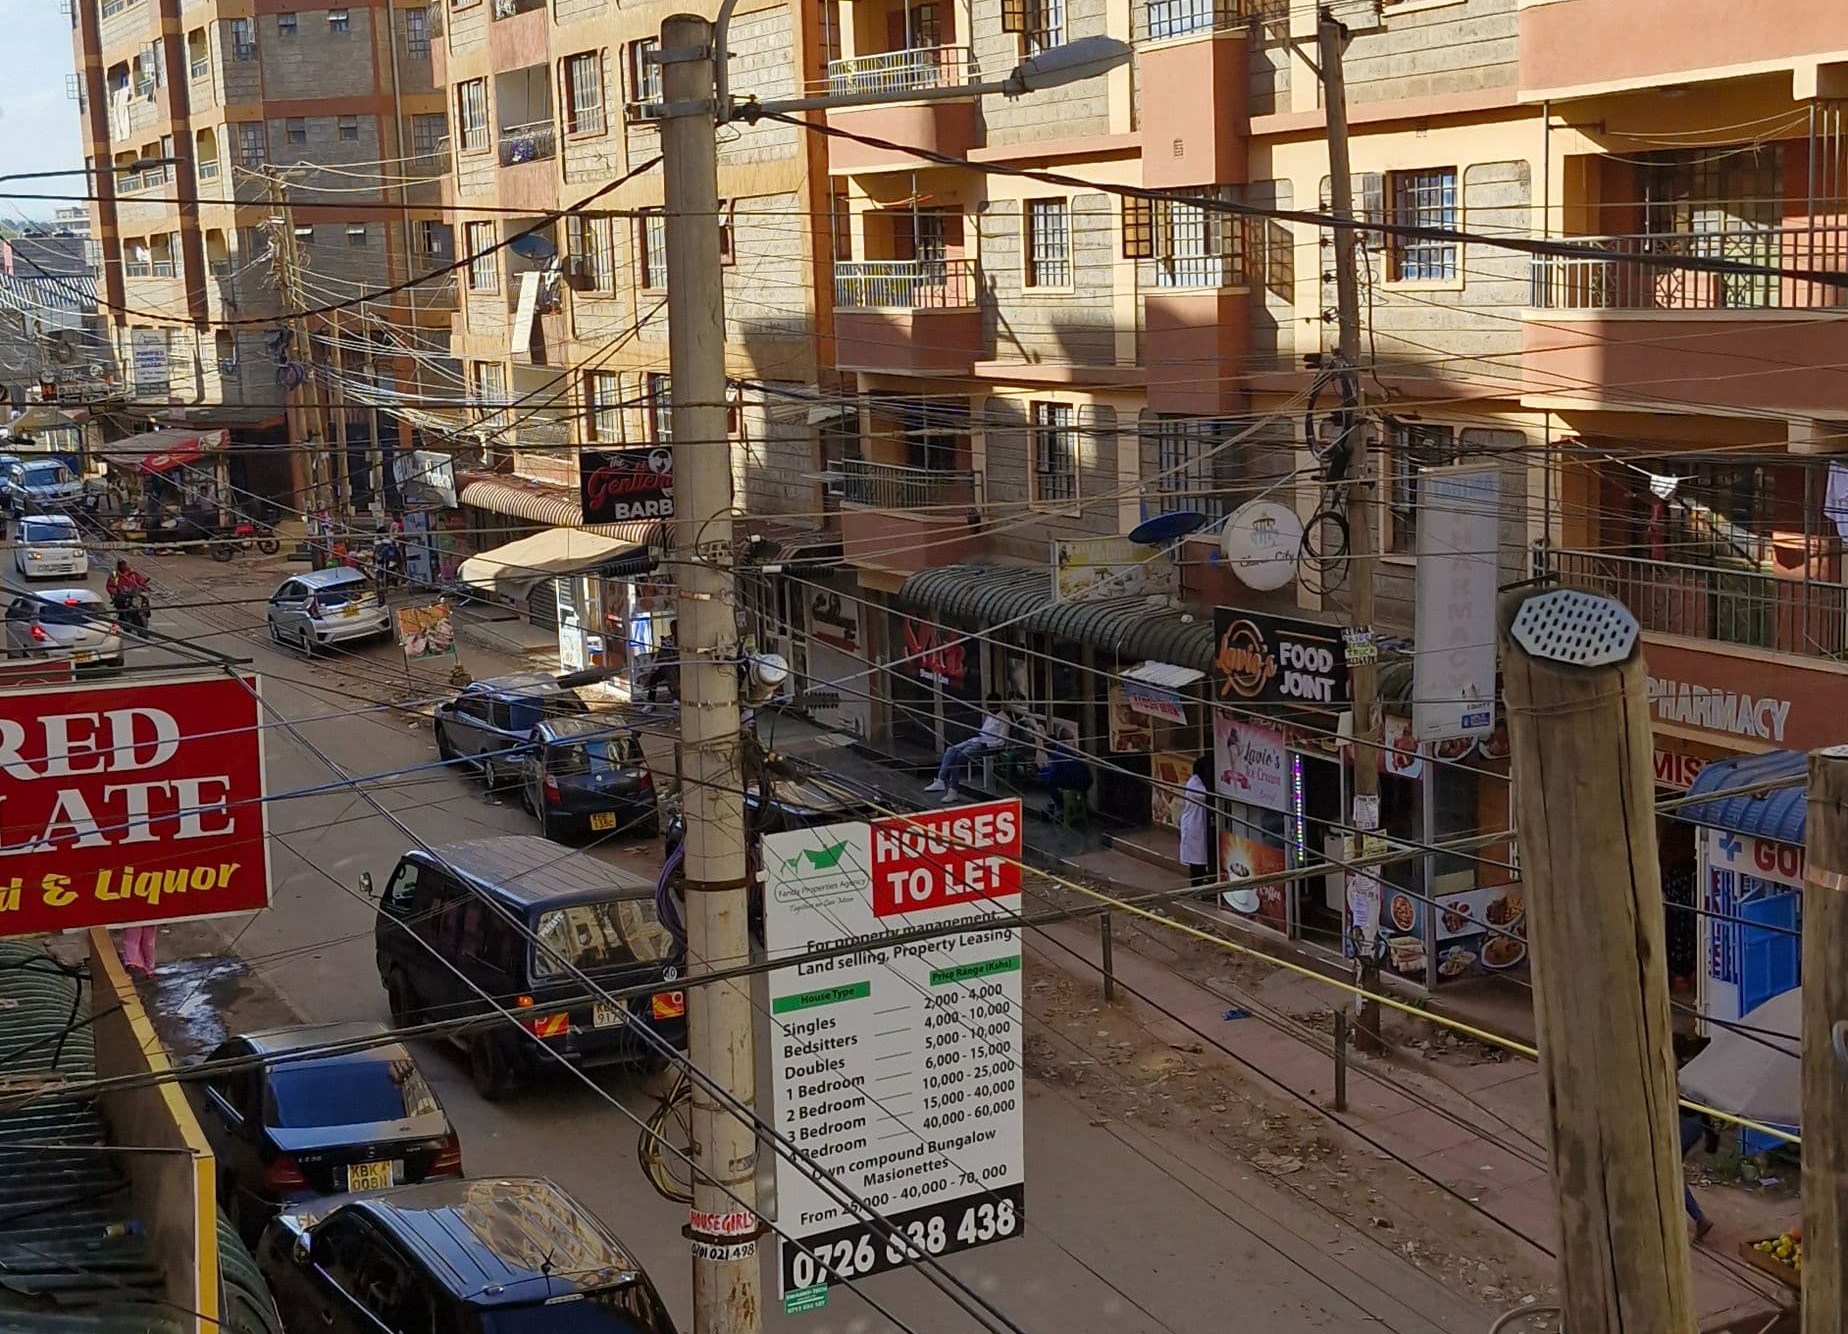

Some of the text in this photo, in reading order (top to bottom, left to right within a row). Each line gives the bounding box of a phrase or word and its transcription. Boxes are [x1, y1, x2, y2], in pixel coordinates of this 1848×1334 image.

[1279, 642, 1334, 673] FOOD
[1280, 670, 1336, 703] JOINT
[1647, 676, 1791, 741] PHARMACY
[1654, 750, 1712, 788] MIS
[876, 812, 1016, 864] HOUSES
[42, 873, 78, 906] &
[95, 863, 240, 905] Liquor
[801, 880, 838, 896] Properties
[839, 876, 867, 889] Agency
[887, 856, 1006, 905] TO LET
[798, 927, 1013, 977] Land selling, Property Leasing
[807, 940, 831, 954] For
[832, 927, 901, 951] property
[932, 959, 1013, 982] Price Range (Kshs)
[801, 986, 855, 1005] House Type
[924, 990, 959, 1010] 2,000
[968, 983, 1003, 1003] 4,000
[783, 1016, 837, 1038] Singles
[924, 1010, 959, 1029] 4,000
[970, 1001, 1010, 1020] 10,000
[784, 1033, 858, 1059] Bedsitters
[925, 1030, 960, 1050] 5,000
[971, 1021, 1011, 1040] 10,000
[785, 1056, 846, 1080] Doubles
[925, 1050, 960, 1070] 6,000
[971, 1040, 1011, 1060] 15,000
[786, 1074, 865, 1101] 1 Bedroom
[922, 1069, 964, 1090] 10,000
[974, 1059, 1015, 1079] 25,000
[786, 1095, 866, 1123] 2 Bedroom
[923, 1089, 964, 1110] 15,000
[974, 1079, 1016, 1099] 40,000
[923, 1109, 965, 1130] 40,000
[974, 1098, 1016, 1119] 60,000
[787, 1116, 866, 1144] 3 Bedroom
[801, 1137, 868, 1161] Bedroom
[812, 1128, 997, 1181] Own compound Bungalow
[351, 1164, 378, 1178] KBK
[863, 1157, 949, 1187] Masionettes
[801, 1205, 837, 1225] From
[900, 1179, 947, 1200] 40,000
[982, 1164, 1007, 1179] 000
[722, 1211, 755, 1234] GIRLS
[709, 1248, 729, 1261] 021
[732, 1243, 755, 1257] 498
[793, 1198, 1016, 1289] 0726 638 438
